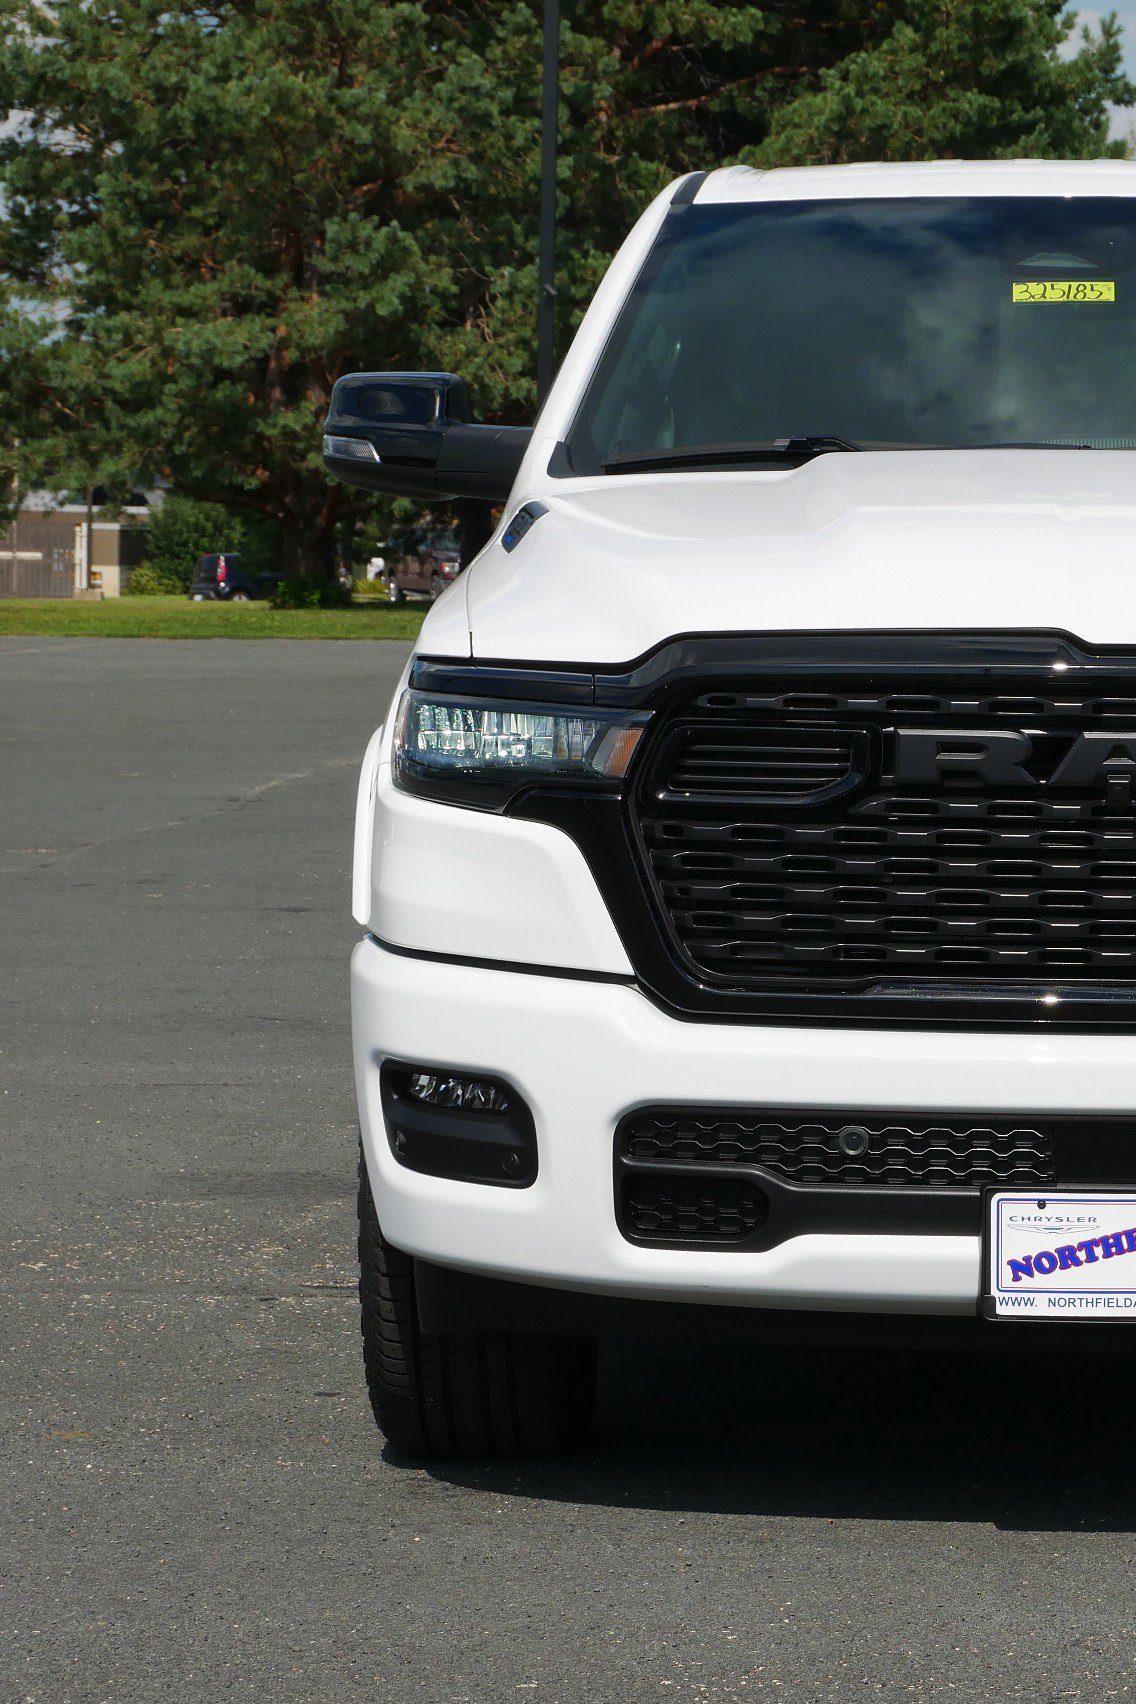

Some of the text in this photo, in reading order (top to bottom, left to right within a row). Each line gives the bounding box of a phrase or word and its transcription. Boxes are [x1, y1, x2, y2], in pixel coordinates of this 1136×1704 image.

[1015, 282, 1104, 301] 325185
[1009, 1215, 1098, 1223] CHRYSLER
[998, 1296, 1038, 1308] WWW.
